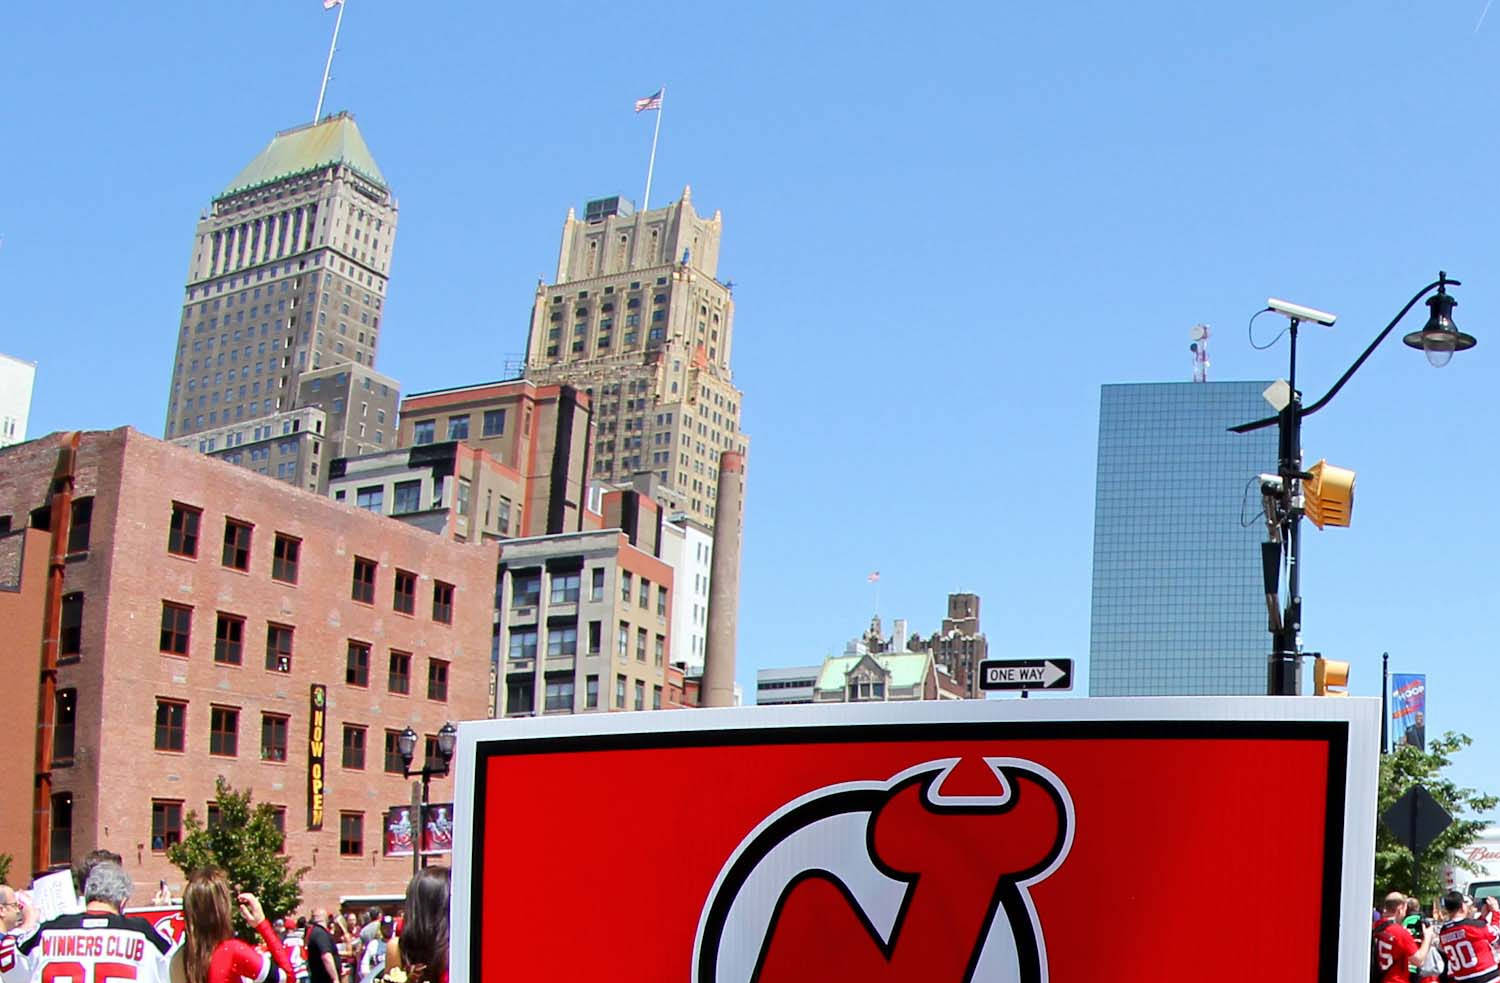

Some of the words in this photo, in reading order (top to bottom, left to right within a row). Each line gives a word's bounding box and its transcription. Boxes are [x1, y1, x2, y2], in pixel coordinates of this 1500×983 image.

[990, 669, 1015, 681] ONE
[1020, 667, 1045, 680] WAY
[311, 711, 323, 758] NOW
[312, 763, 323, 825] OPEN
[42, 935, 103, 957] WINNERS
[106, 936, 144, 962] CLUB
[1444, 940, 1478, 975] 30
